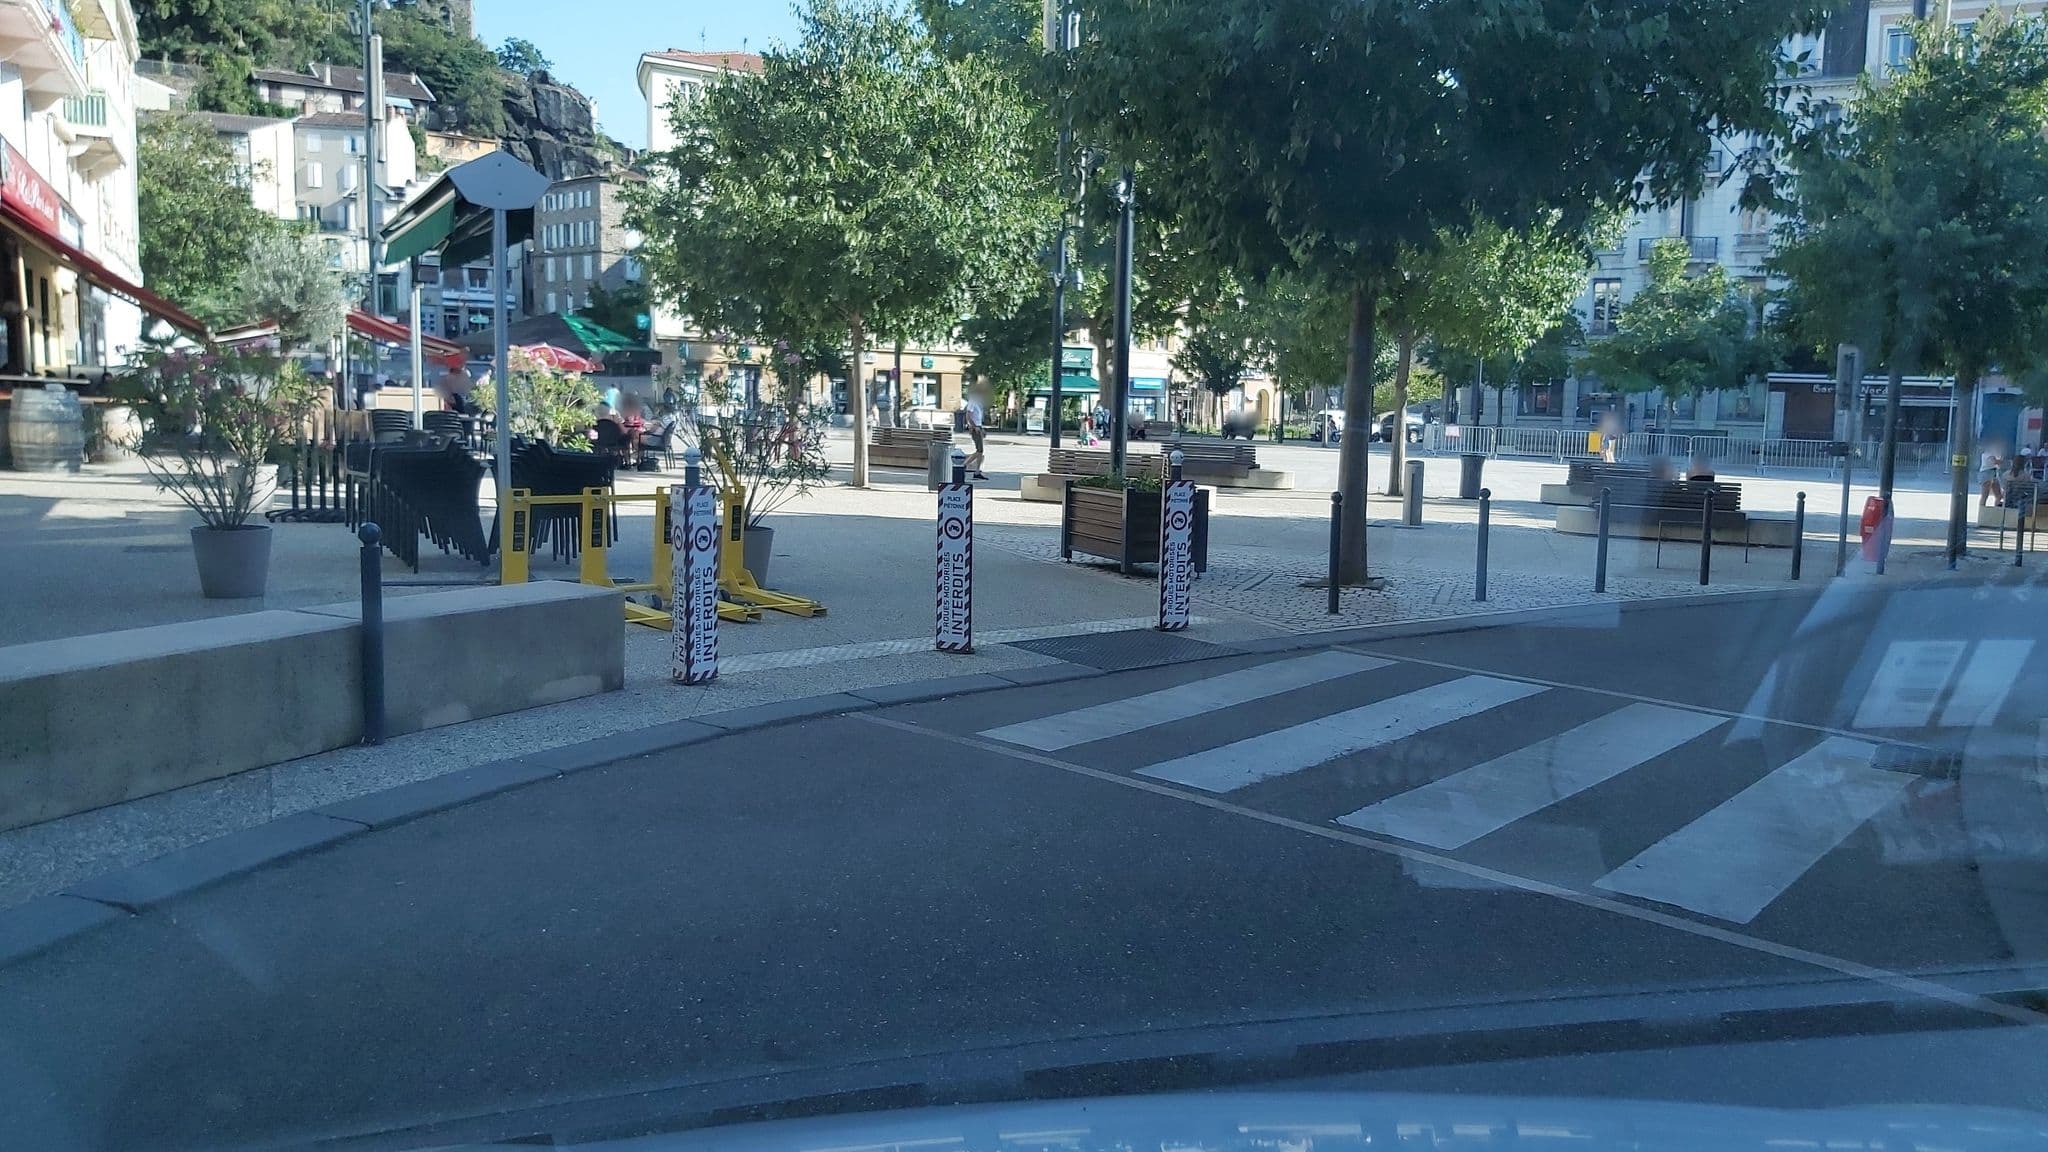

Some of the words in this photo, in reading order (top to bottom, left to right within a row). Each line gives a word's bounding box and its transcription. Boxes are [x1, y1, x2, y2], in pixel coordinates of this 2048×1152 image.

[703, 566, 713, 661] INTERDITS
[952, 553, 964, 635] INTERDITS
[1175, 542, 1186, 615] INTERDITS
